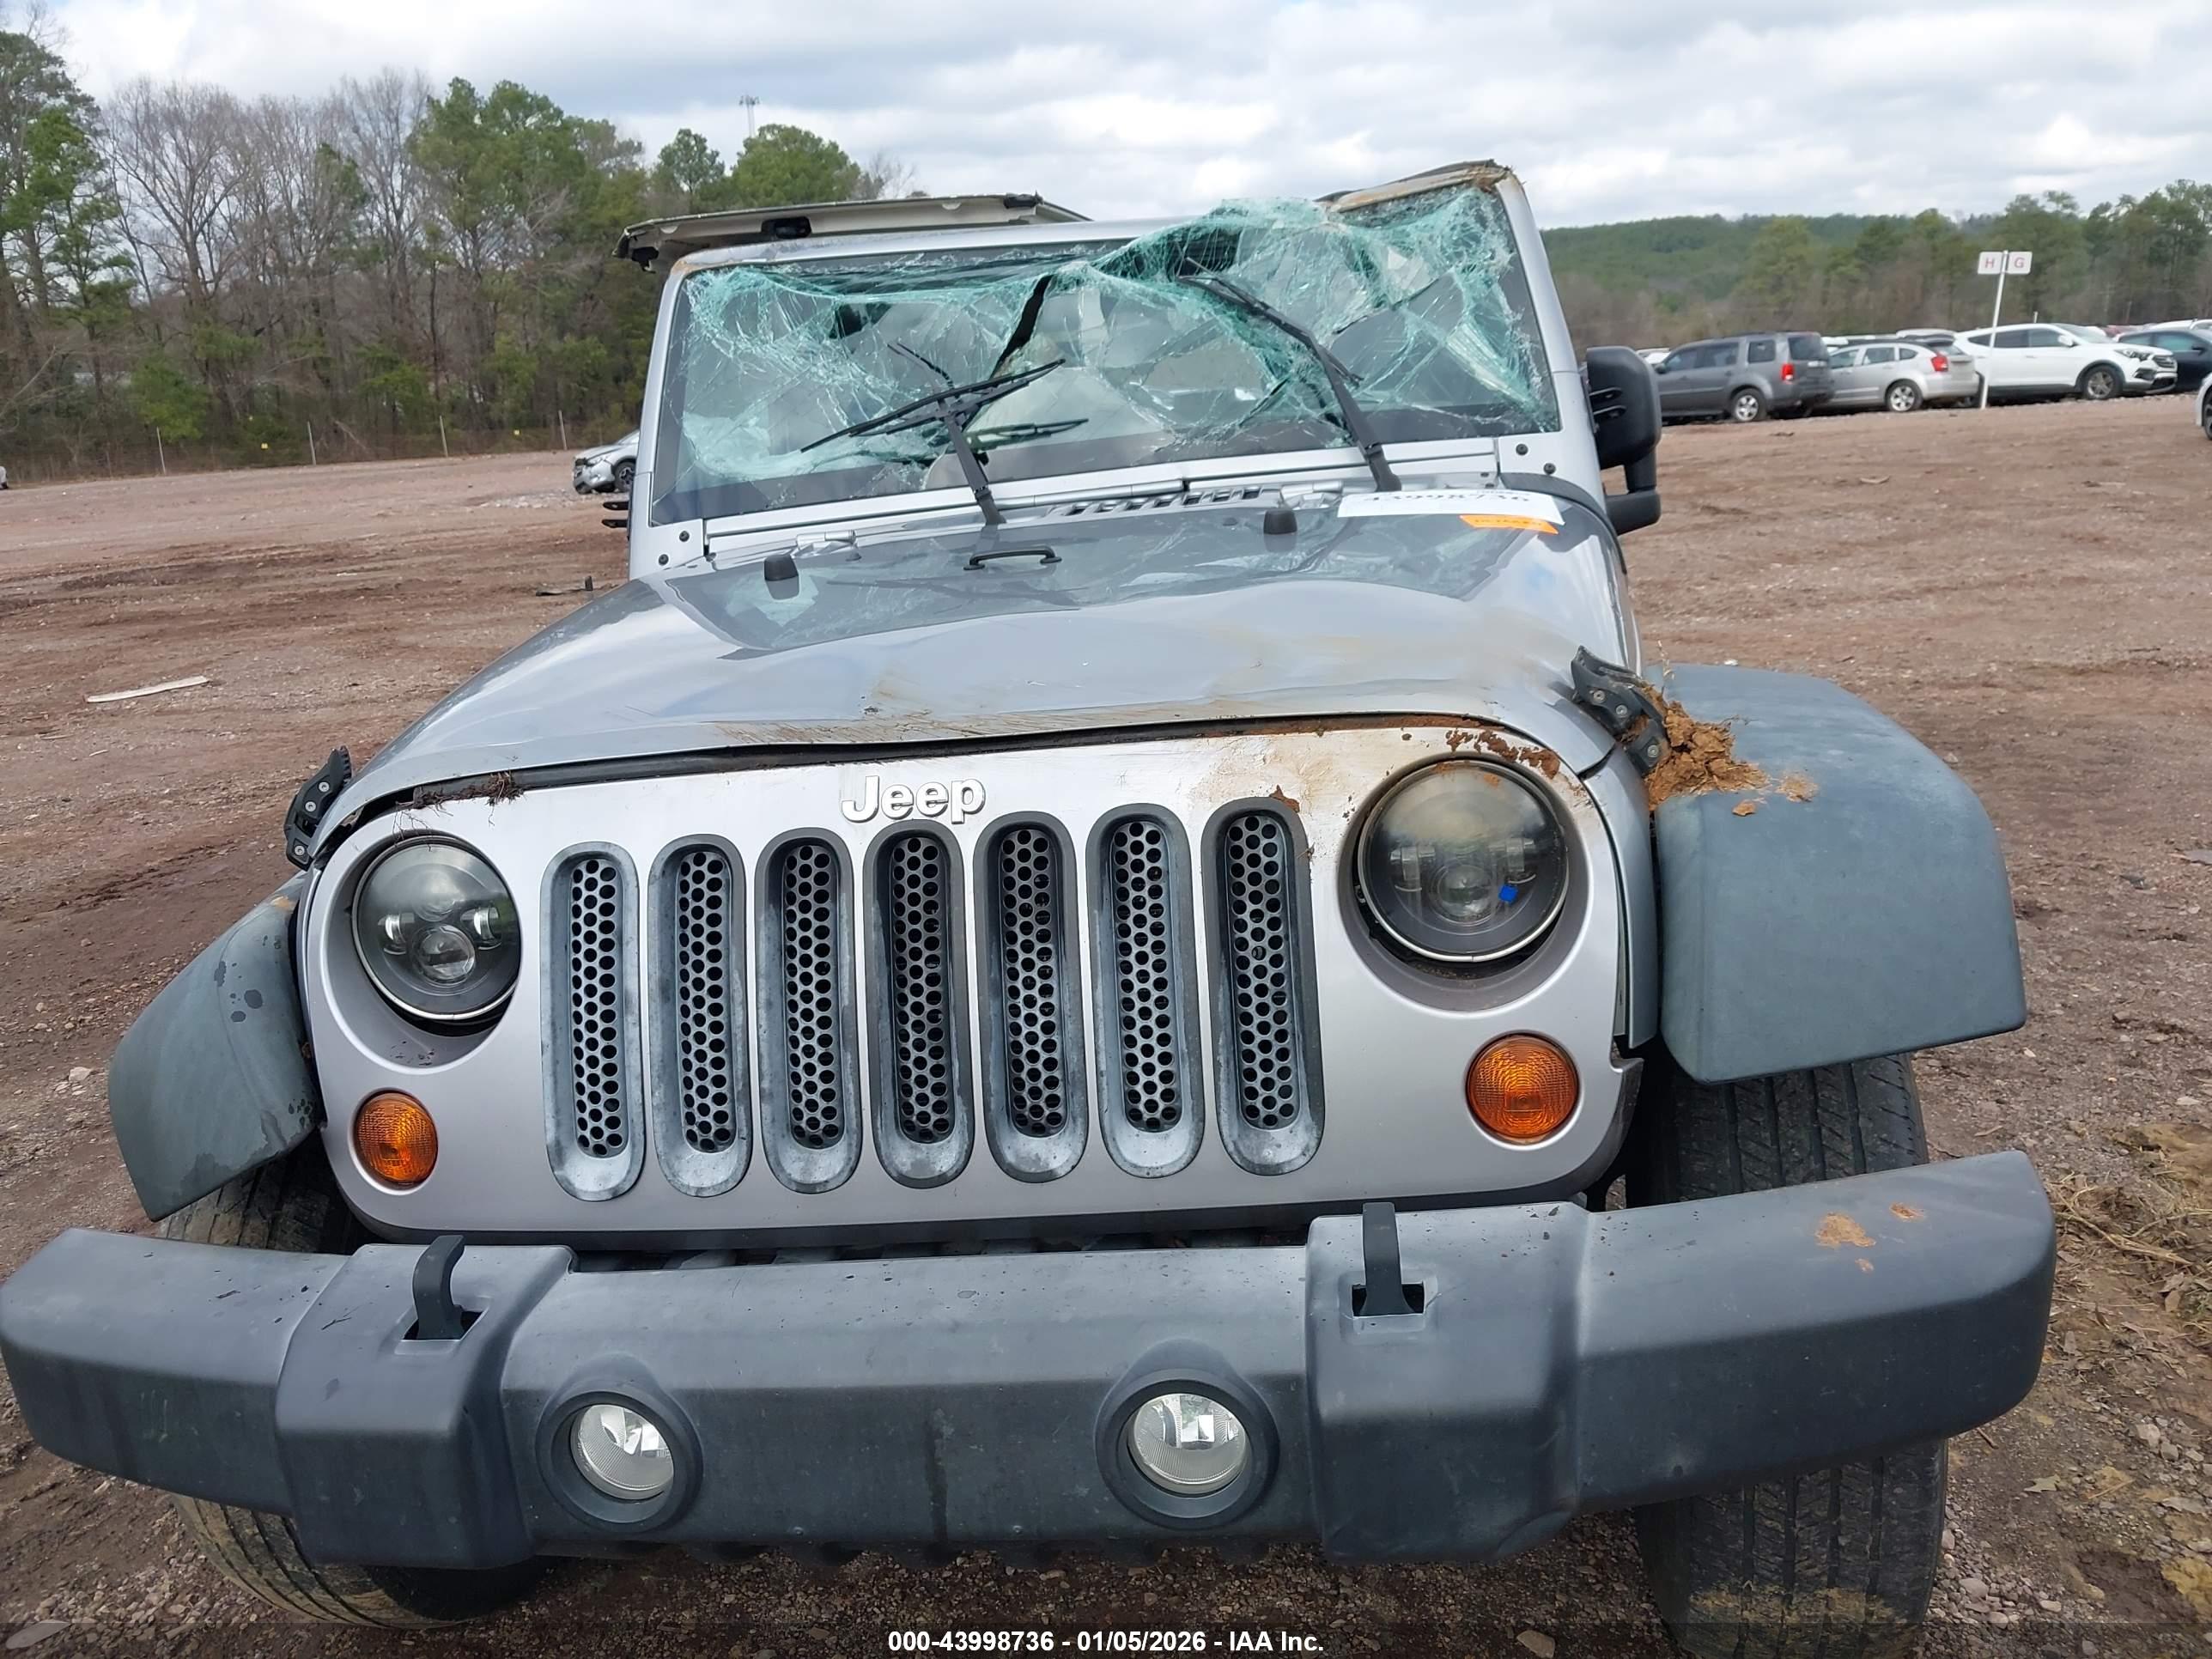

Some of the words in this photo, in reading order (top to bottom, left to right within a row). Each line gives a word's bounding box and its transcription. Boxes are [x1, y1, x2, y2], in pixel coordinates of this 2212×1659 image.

[1985, 258, 1996, 268] H
[2014, 257, 2025, 268] G
[841, 775, 987, 824] Jeep
